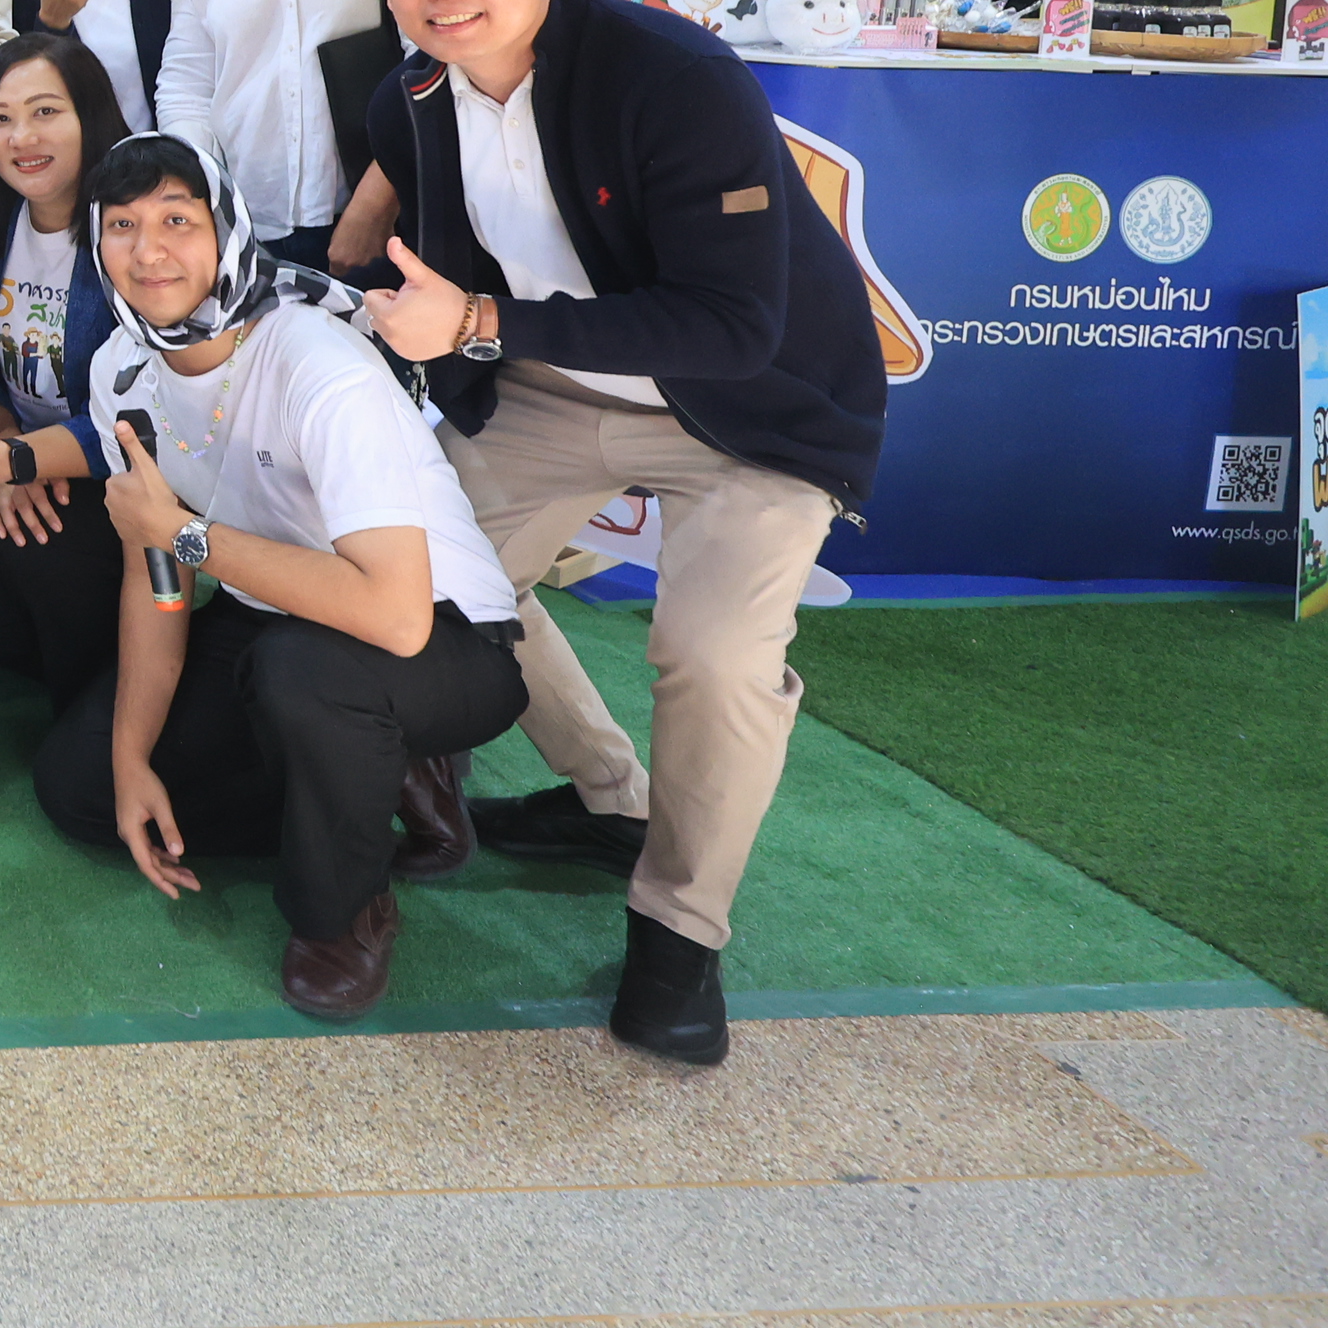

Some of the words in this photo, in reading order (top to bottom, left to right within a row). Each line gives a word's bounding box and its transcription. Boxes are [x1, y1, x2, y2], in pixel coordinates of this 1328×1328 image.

[1010, 276, 1211, 312] กรมหม่อนไหม
